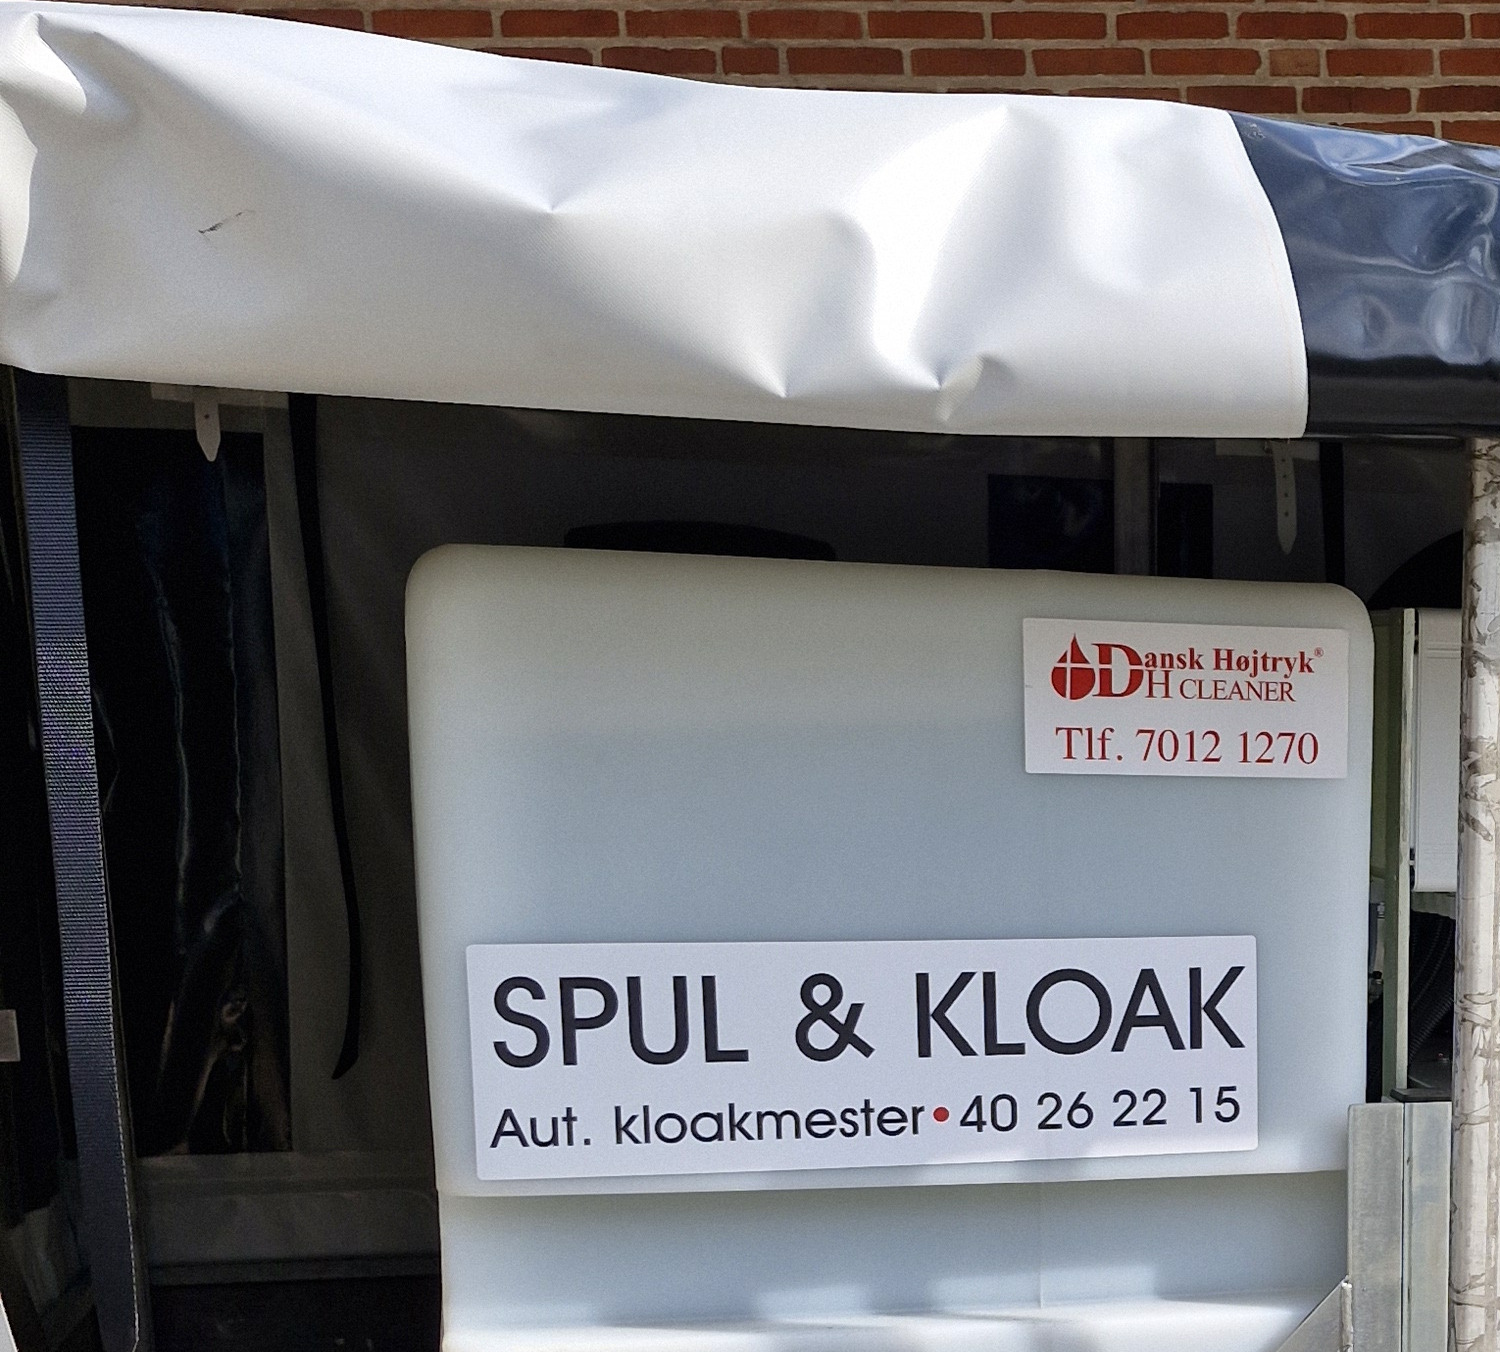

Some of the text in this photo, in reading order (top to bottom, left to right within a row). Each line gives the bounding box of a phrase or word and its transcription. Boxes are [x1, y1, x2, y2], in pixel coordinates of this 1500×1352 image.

[1091, 642, 1204, 698] Dansk
[1179, 678, 1297, 703] CLEANER
[1055, 727, 1320, 765] Tlf. 7012 1270
[492, 965, 1246, 1068] SPUL & KLOAK
[490, 1086, 1242, 1148] Aut. kloakmester 40 26 22 15
